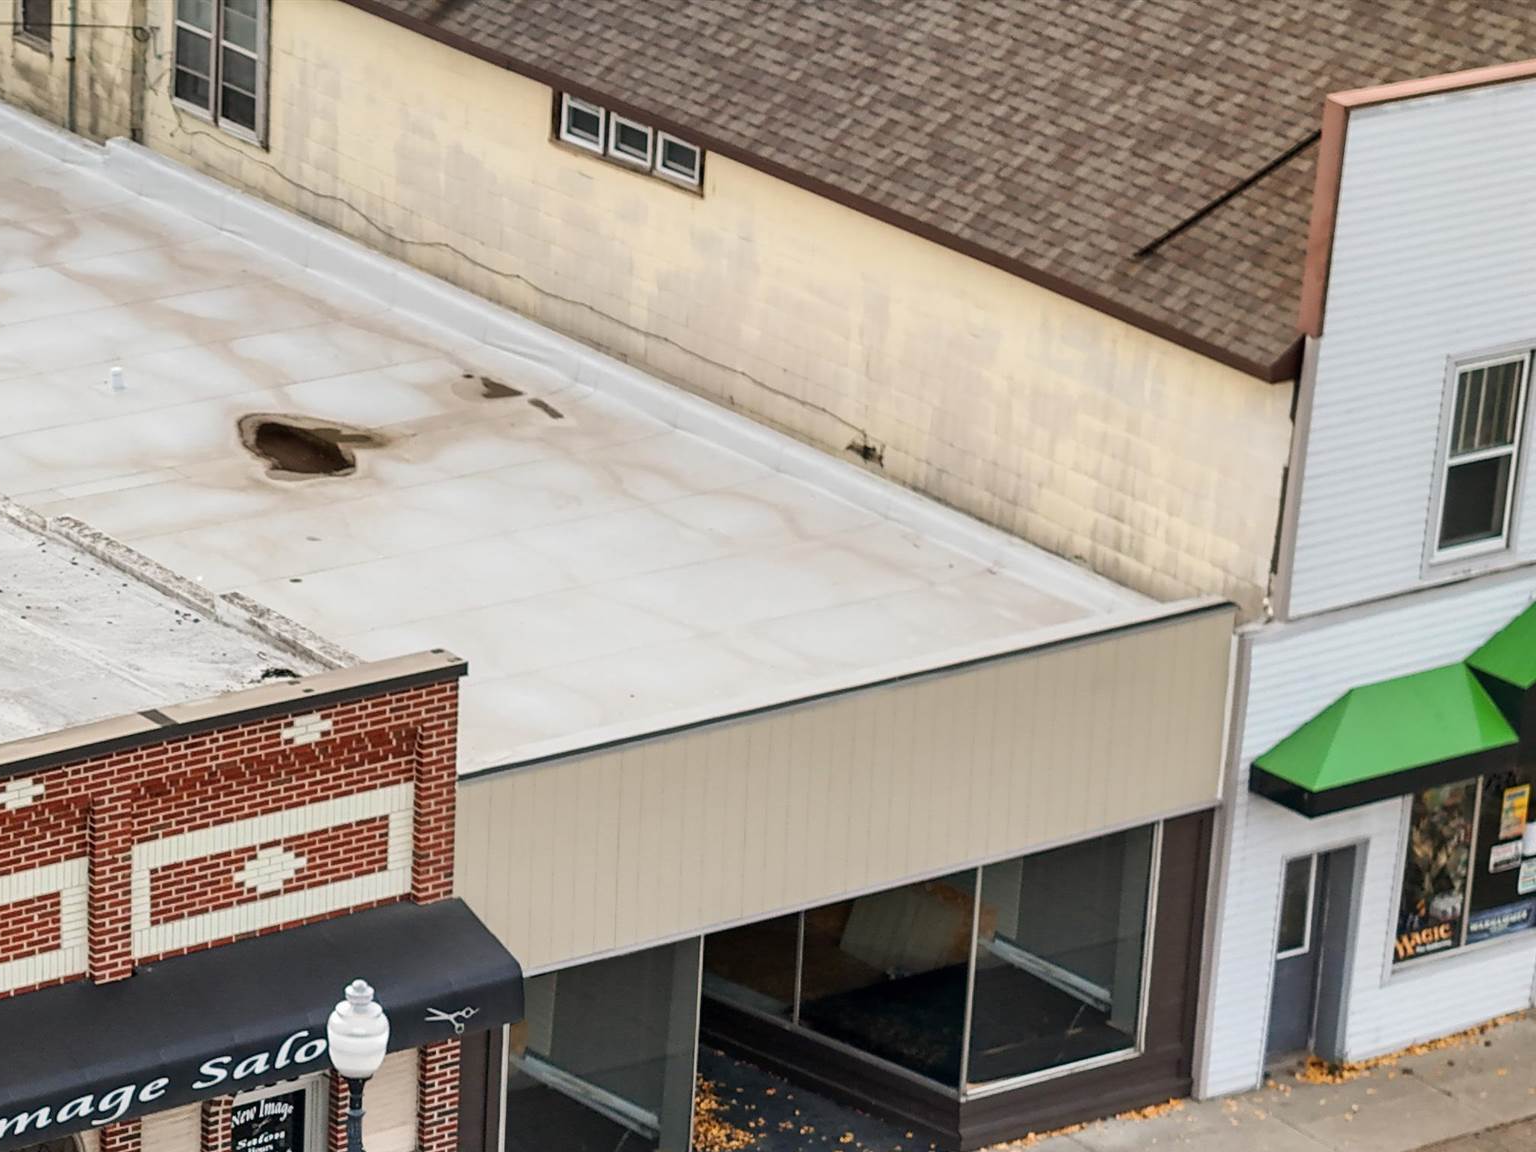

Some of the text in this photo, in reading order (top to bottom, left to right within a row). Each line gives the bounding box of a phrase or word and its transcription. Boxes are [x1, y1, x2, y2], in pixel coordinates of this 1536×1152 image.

[1394, 922, 1452, 959] MAGIC
[191, 1030, 327, 1089] Salo
[231, 1099, 294, 1129] New Image
